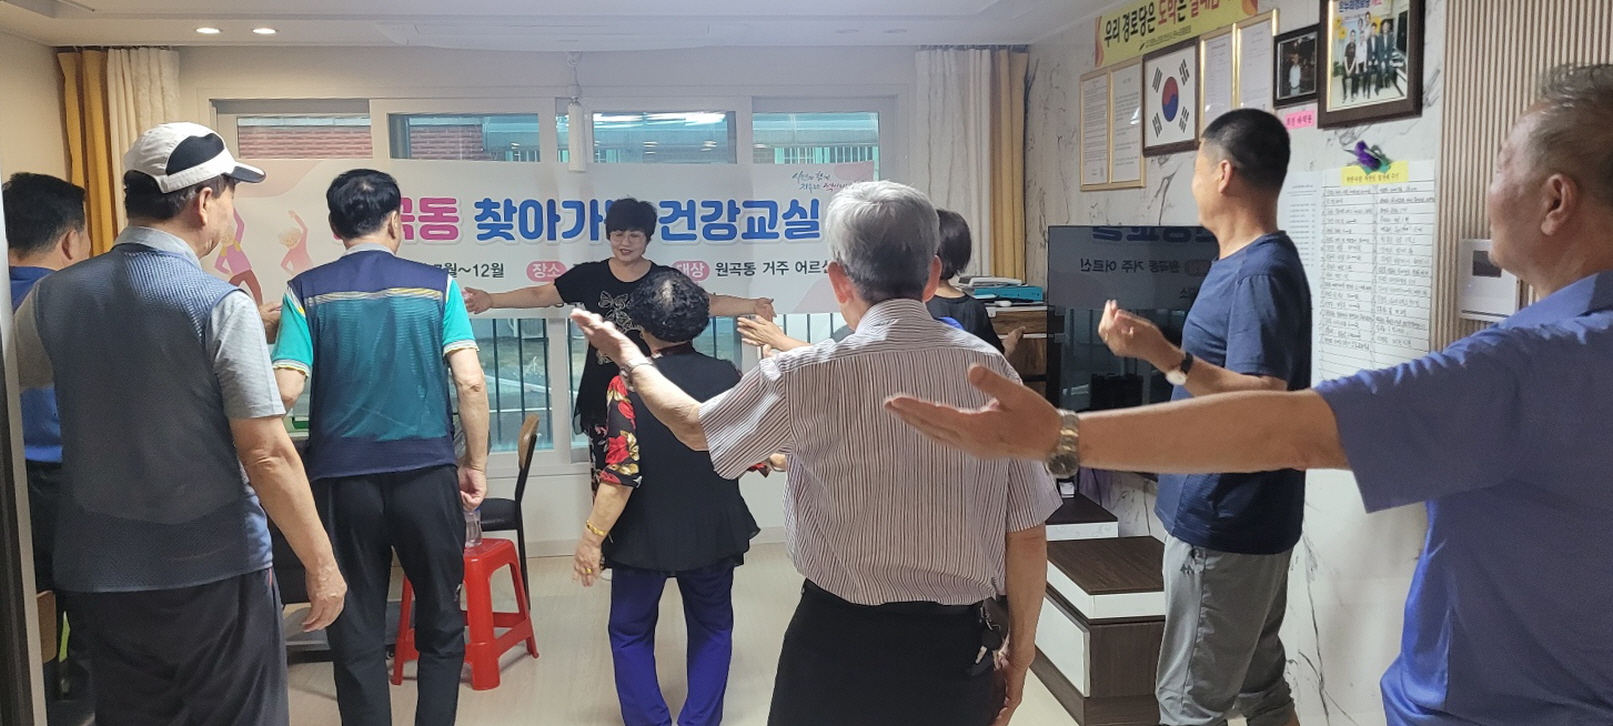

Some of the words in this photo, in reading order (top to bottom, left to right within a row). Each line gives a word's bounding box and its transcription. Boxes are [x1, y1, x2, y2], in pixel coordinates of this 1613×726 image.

[1104, 20, 1120, 47] 우리
[1122, 3, 1156, 43] 경로당은
[474, 198, 606, 241] 찾아가
[659, 198, 820, 241] 건강교실
[532, 264, 562, 278] 장소
[676, 264, 705, 279] 대상
[715, 262, 757, 277] 원곡동
[763, 261, 790, 276] 거주
